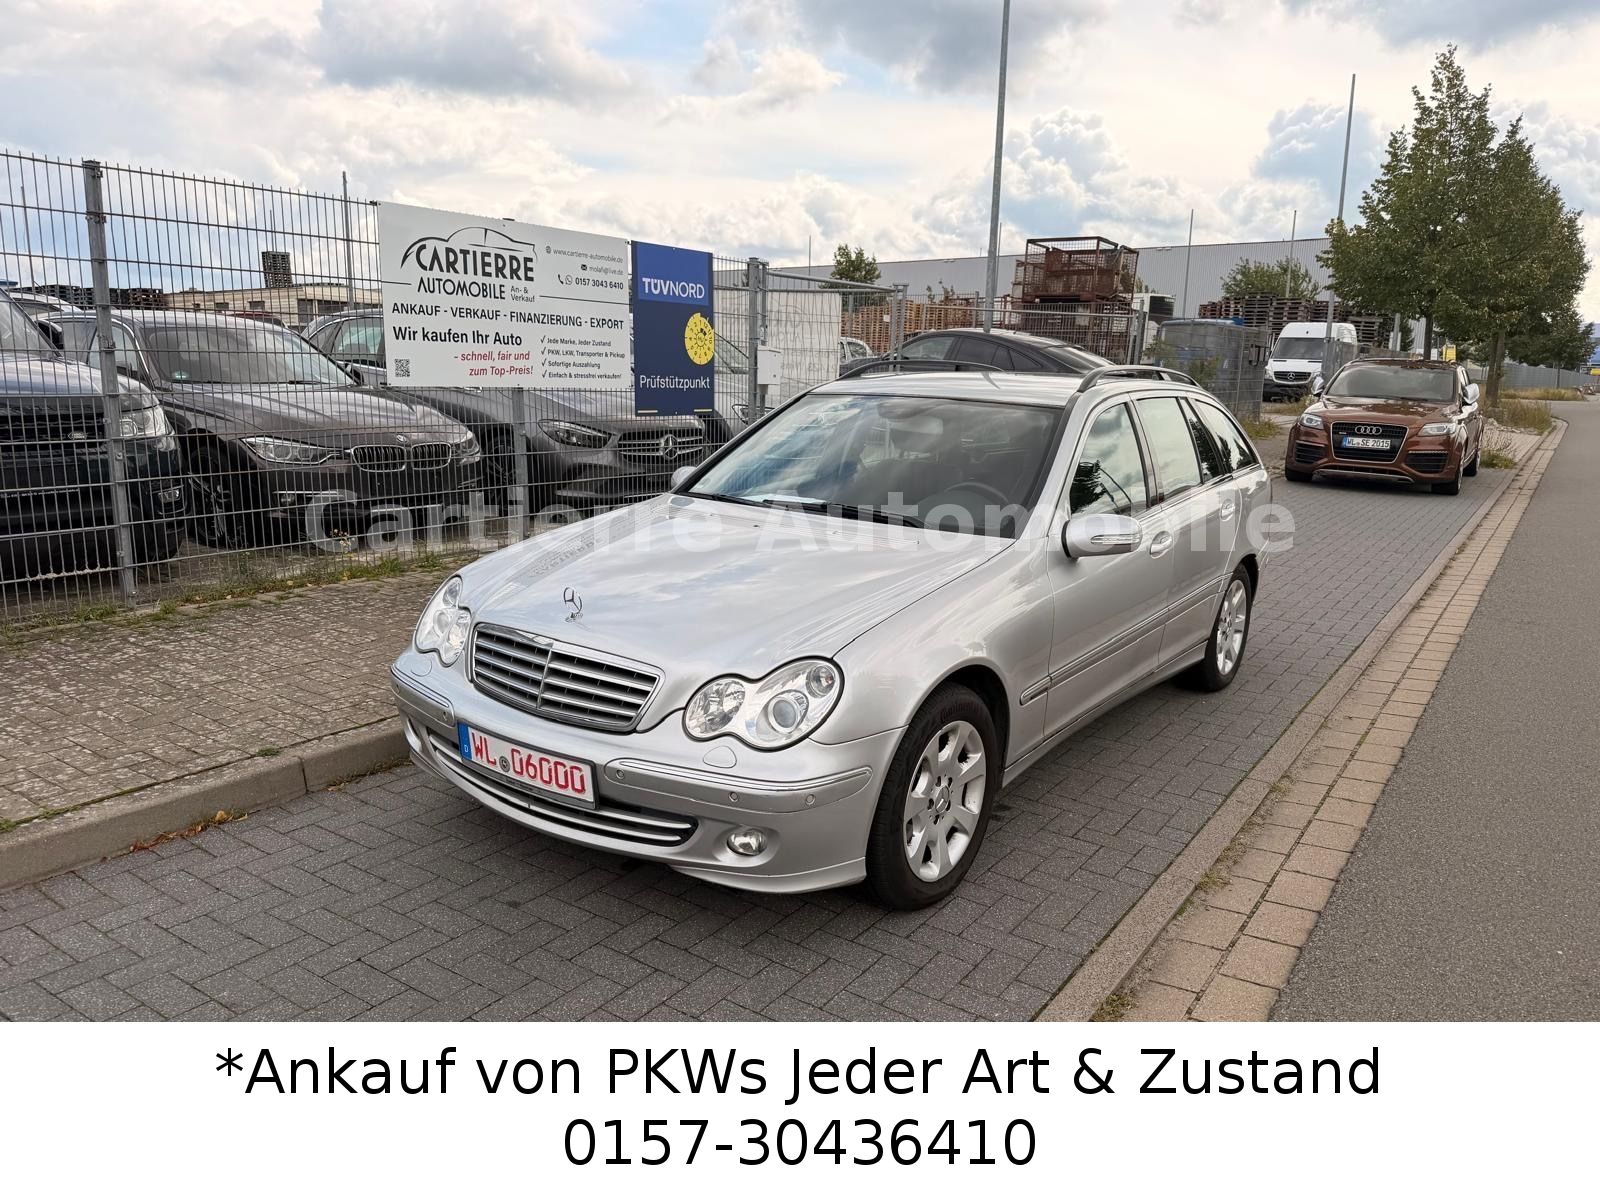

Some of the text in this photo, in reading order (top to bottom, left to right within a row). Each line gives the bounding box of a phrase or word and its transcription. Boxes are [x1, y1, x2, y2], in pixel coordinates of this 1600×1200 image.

[415, 243, 534, 282] CARTIERRE
[417, 276, 506, 300] AUTOMOBILE
[575, 277, 624, 290] 0157 3043 6410
[523, 286, 529, 294] &
[510, 293, 535, 303] Verkauf
[392, 302, 441, 316] ANKAUF
[450, 306, 500, 320] VERKAUF
[510, 311, 582, 327] FINANZIERUNG
[590, 317, 624, 330] EXPORT
[392, 326, 523, 346] Wir kaufen Ihr Auto
[461, 351, 495, 362] schnell,
[497, 351, 512, 361] fair
[513, 351, 530, 361] und
[548, 349, 561, 357] PKW,
[576, 350, 604, 358] Transporter
[548, 360, 600, 369] Sofortige Auszahlung
[469, 366, 534, 378] zum Top-Preis!
[549, 371, 568, 379] Einfach
[640, 374, 710, 392] Prüfstützpunkt
[1372, 440, 1390, 448] 2015
[472, 731, 497, 766] WL
[511, 748, 586, 794] 06000
